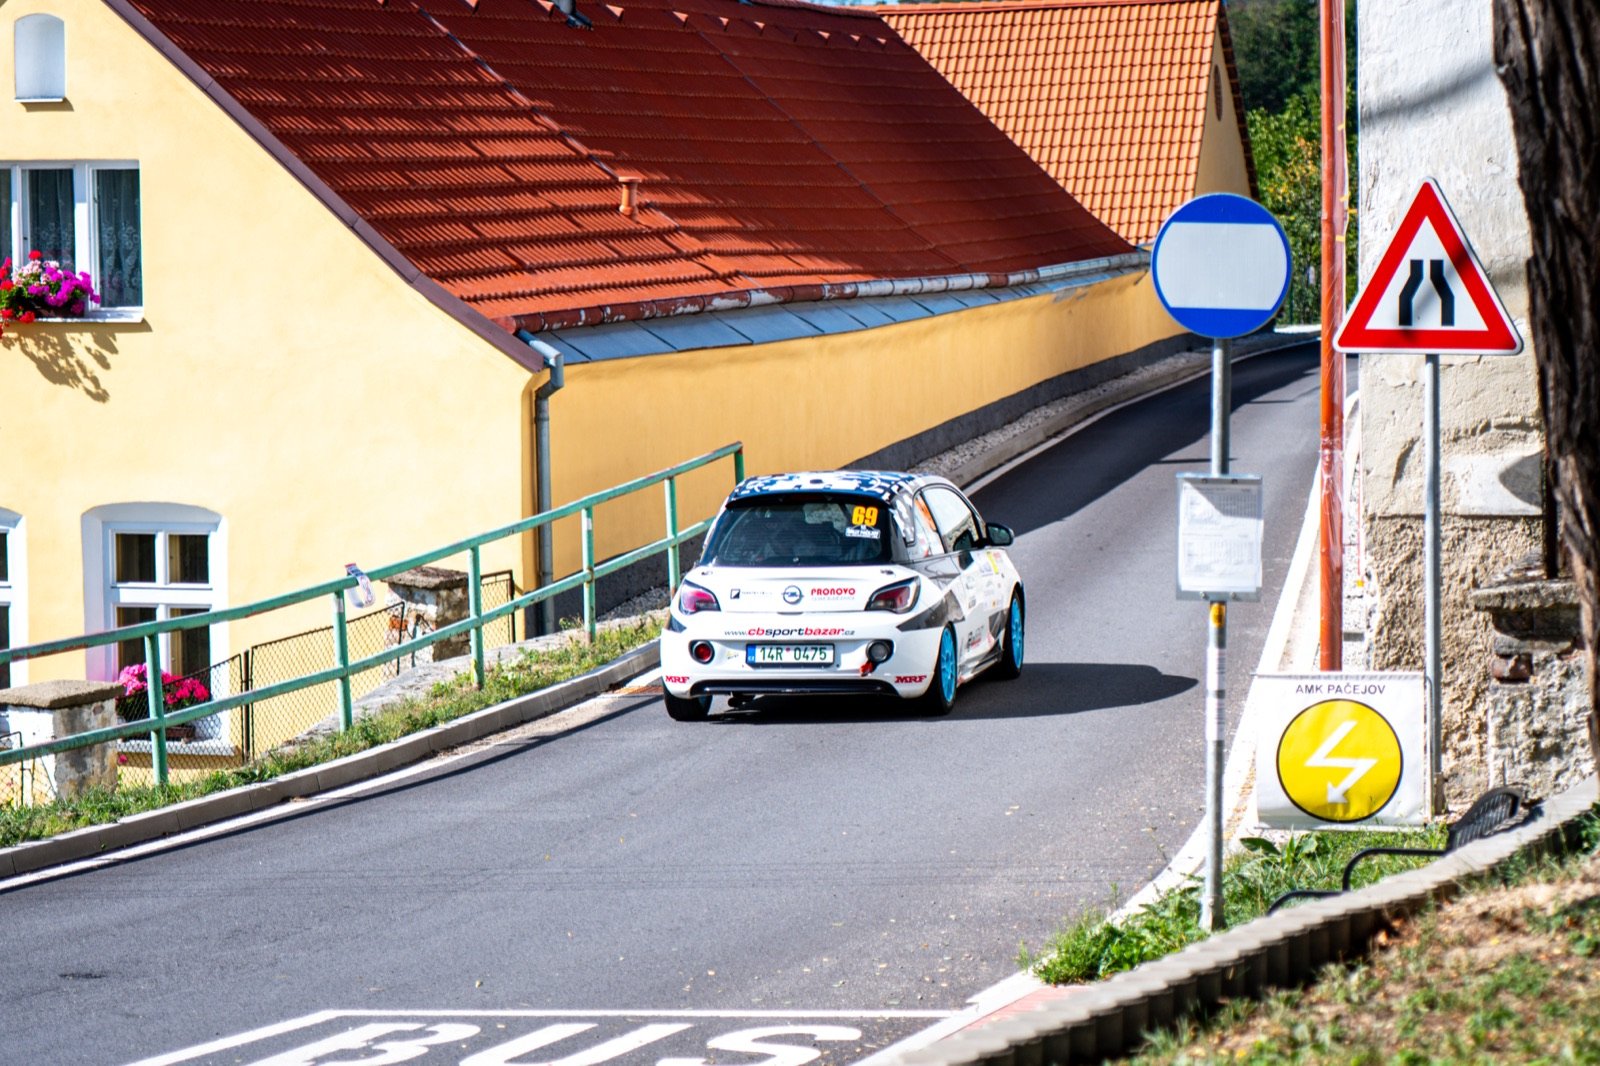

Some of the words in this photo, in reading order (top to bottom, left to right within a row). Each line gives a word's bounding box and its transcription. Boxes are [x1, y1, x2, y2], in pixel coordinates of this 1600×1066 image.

[852, 506, 878, 526] 69
[811, 588, 856, 596] PRONOVO
[724, 627, 855, 637] www.cbsportbazar.cz
[760, 647, 784, 661] 14R
[793, 647, 827, 661] 0475
[665, 675, 690, 684] MRF
[895, 675, 927, 684] MRF
[1296, 684, 1323, 694] AMK
[1327, 682, 1386, 695] PAČEJOV
[245, 1023, 862, 1066] BUS
